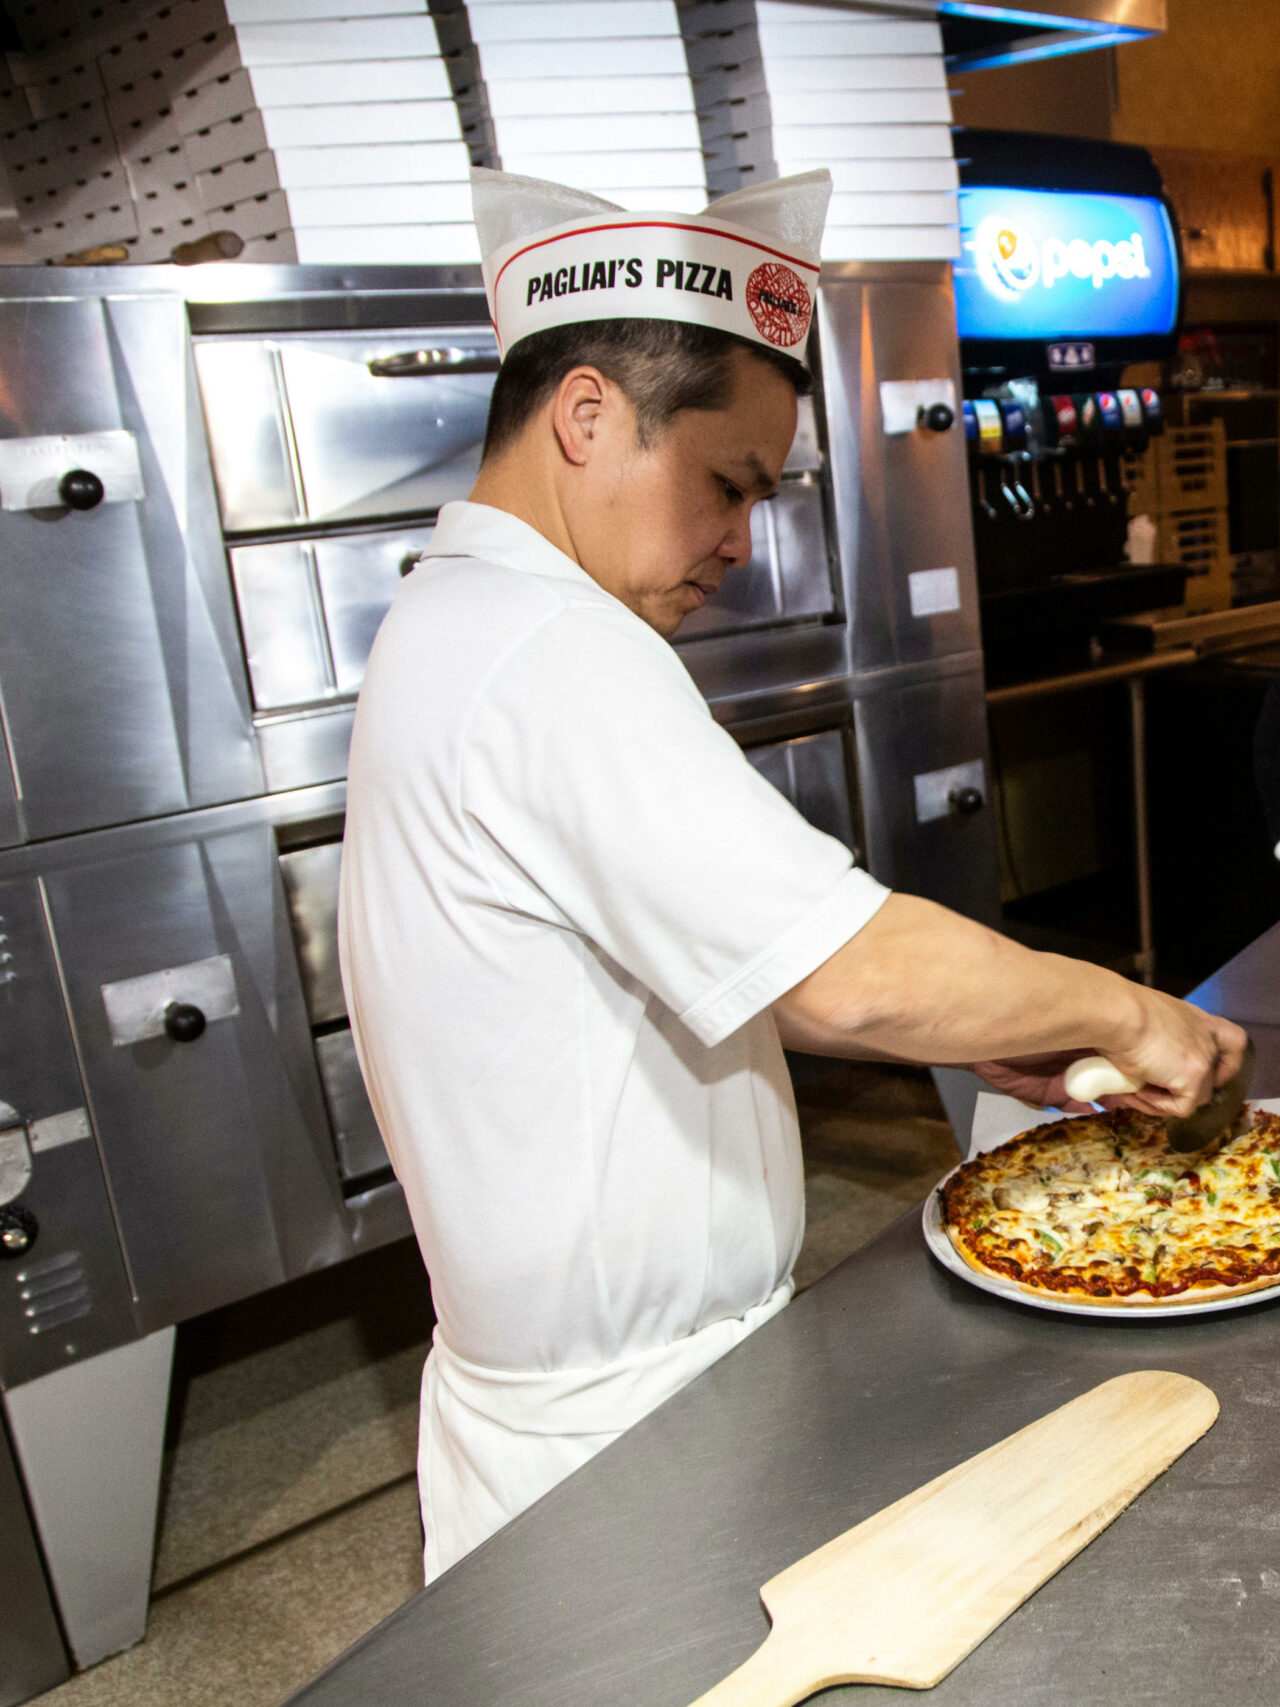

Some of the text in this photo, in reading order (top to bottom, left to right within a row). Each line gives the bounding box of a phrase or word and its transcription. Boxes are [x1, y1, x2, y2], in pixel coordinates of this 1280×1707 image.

[527, 258, 733, 306] PAGLIAI'S PIZZA
[1042, 233, 1147, 288] pepsi
